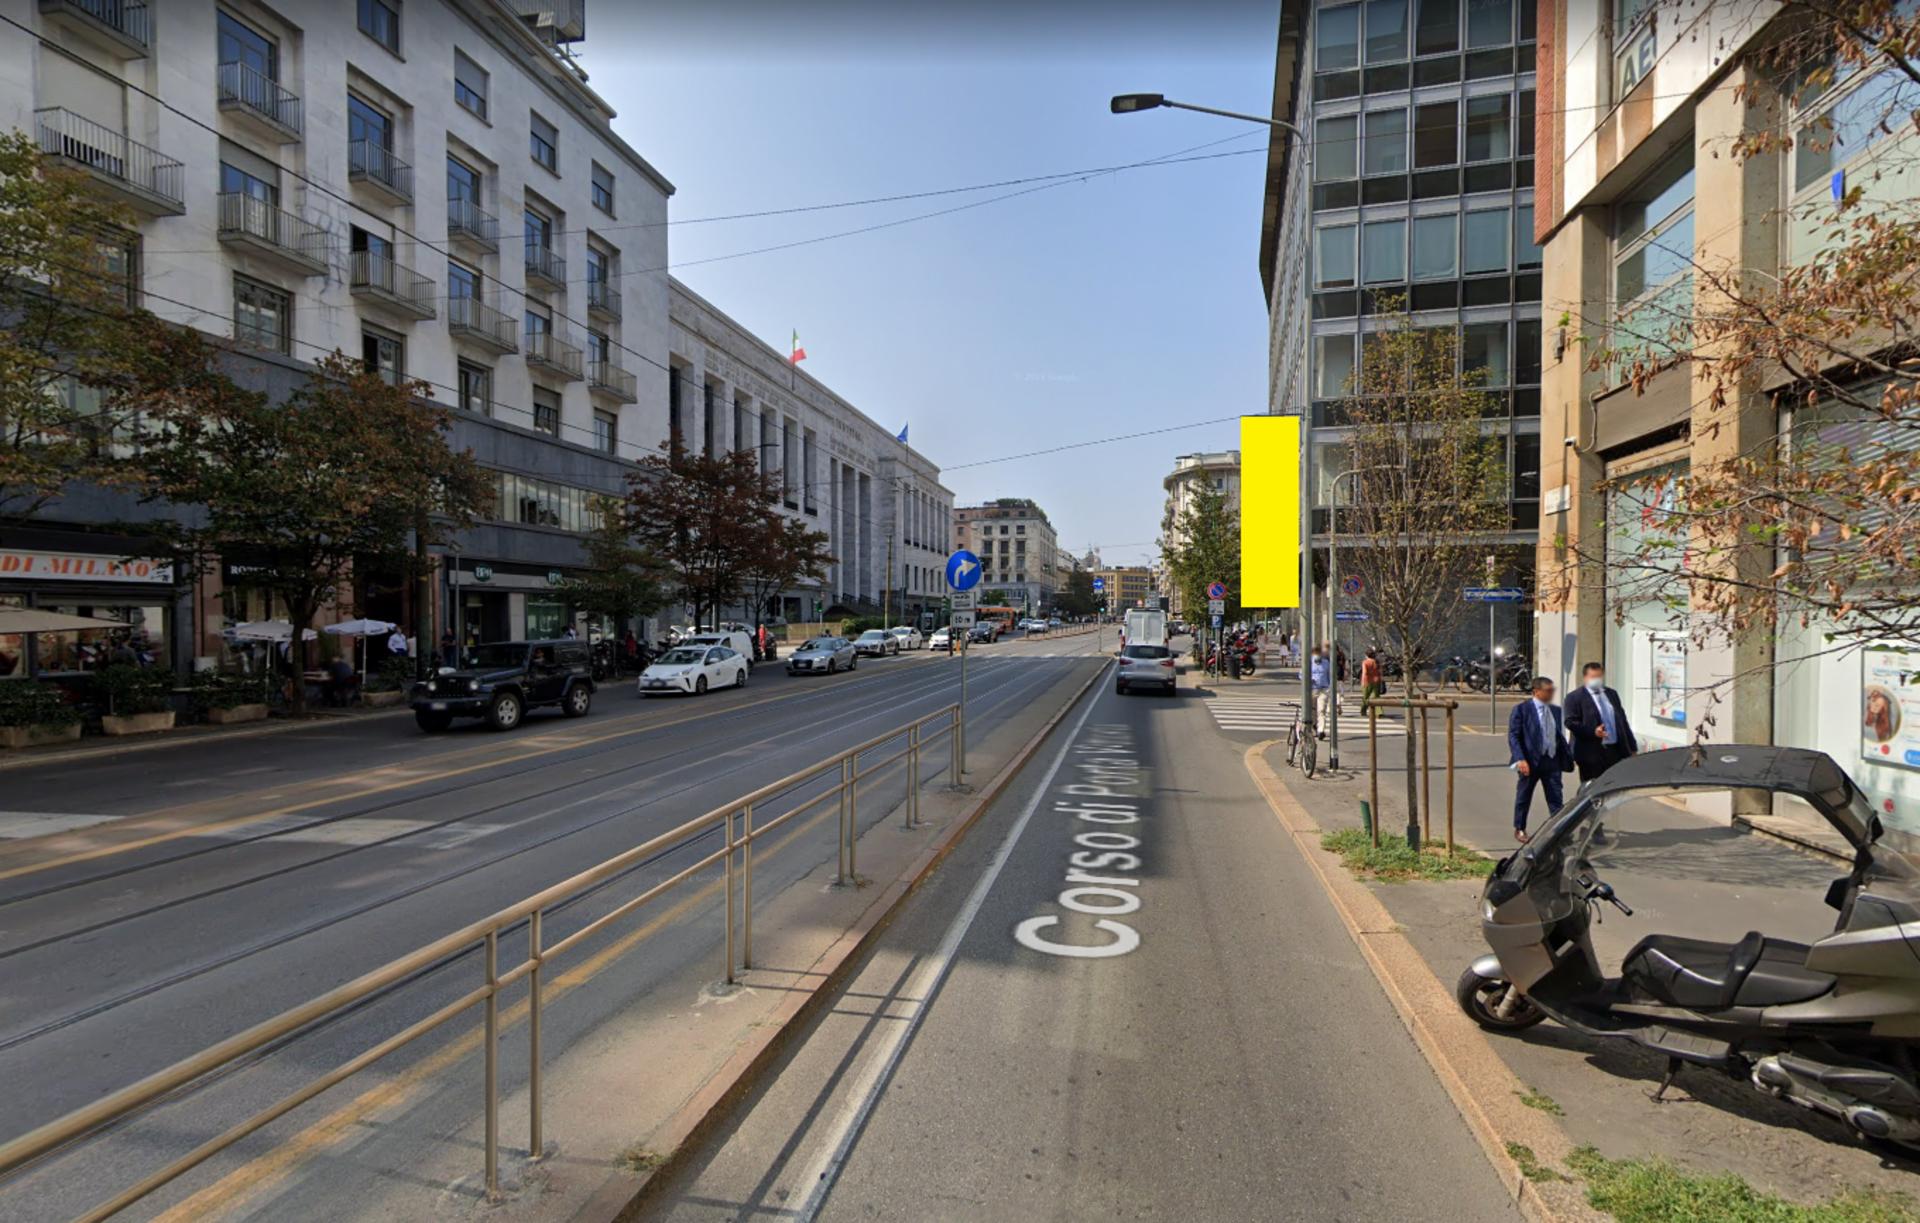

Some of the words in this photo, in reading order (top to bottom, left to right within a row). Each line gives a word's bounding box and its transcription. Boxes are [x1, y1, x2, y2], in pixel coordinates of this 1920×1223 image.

[2, 555, 35, 573] DI
[1053, 801, 1140, 824] di
[1014, 831, 1141, 958] Corso
